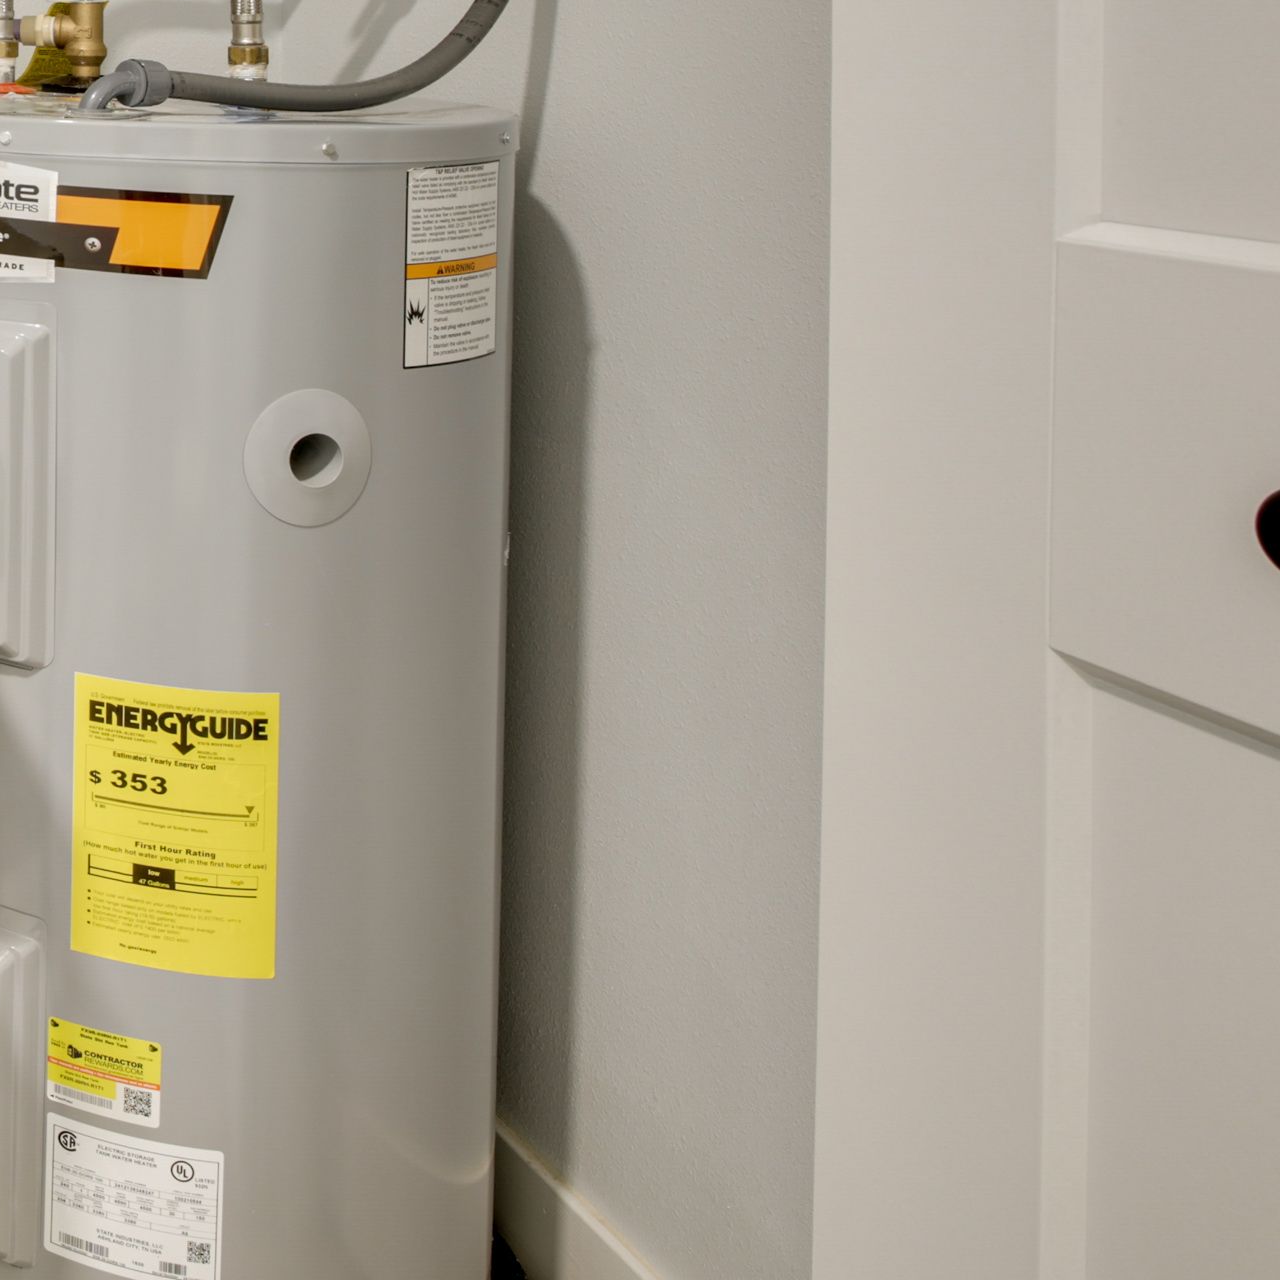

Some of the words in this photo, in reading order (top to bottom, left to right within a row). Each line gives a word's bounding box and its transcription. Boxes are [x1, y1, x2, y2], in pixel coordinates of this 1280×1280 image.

[445, 262, 476, 273] WARNING
[89, 699, 269, 741] ENERGYGUIDE
[112, 751, 147, 762] Estimated
[150, 757, 172, 767] Yearly
[174, 760, 198, 770] Energy
[89, 770, 102, 785] $
[110, 770, 168, 795] 353
[83, 840, 100, 849] (How
[103, 844, 122, 853] much
[124, 846, 137, 855] hot
[138, 850, 158, 860] water
[174, 855, 187, 864] get
[188, 857, 195, 865] in
[197, 858, 208, 866] the
[226, 861, 242, 869] hour
[252, 863, 267, 871] use)
[135, 841, 156, 851] First
[160, 845, 182, 855] Hour
[185, 848, 216, 860] Rating
[84, 1050, 144, 1069] CONTRACTOR
[84, 1057, 144, 1076] REWARDS.COM
[96, 1149, 111, 1158] TANK
[112, 1154, 133, 1163] WATER
[134, 1158, 157, 1168] HEATER
[97, 1144, 126, 1156] ELECTRIC
[127, 1150, 155, 1162] STORAGE
[96, 1228, 113, 1237] STATE
[97, 1234, 124, 1247] ASHLAND
